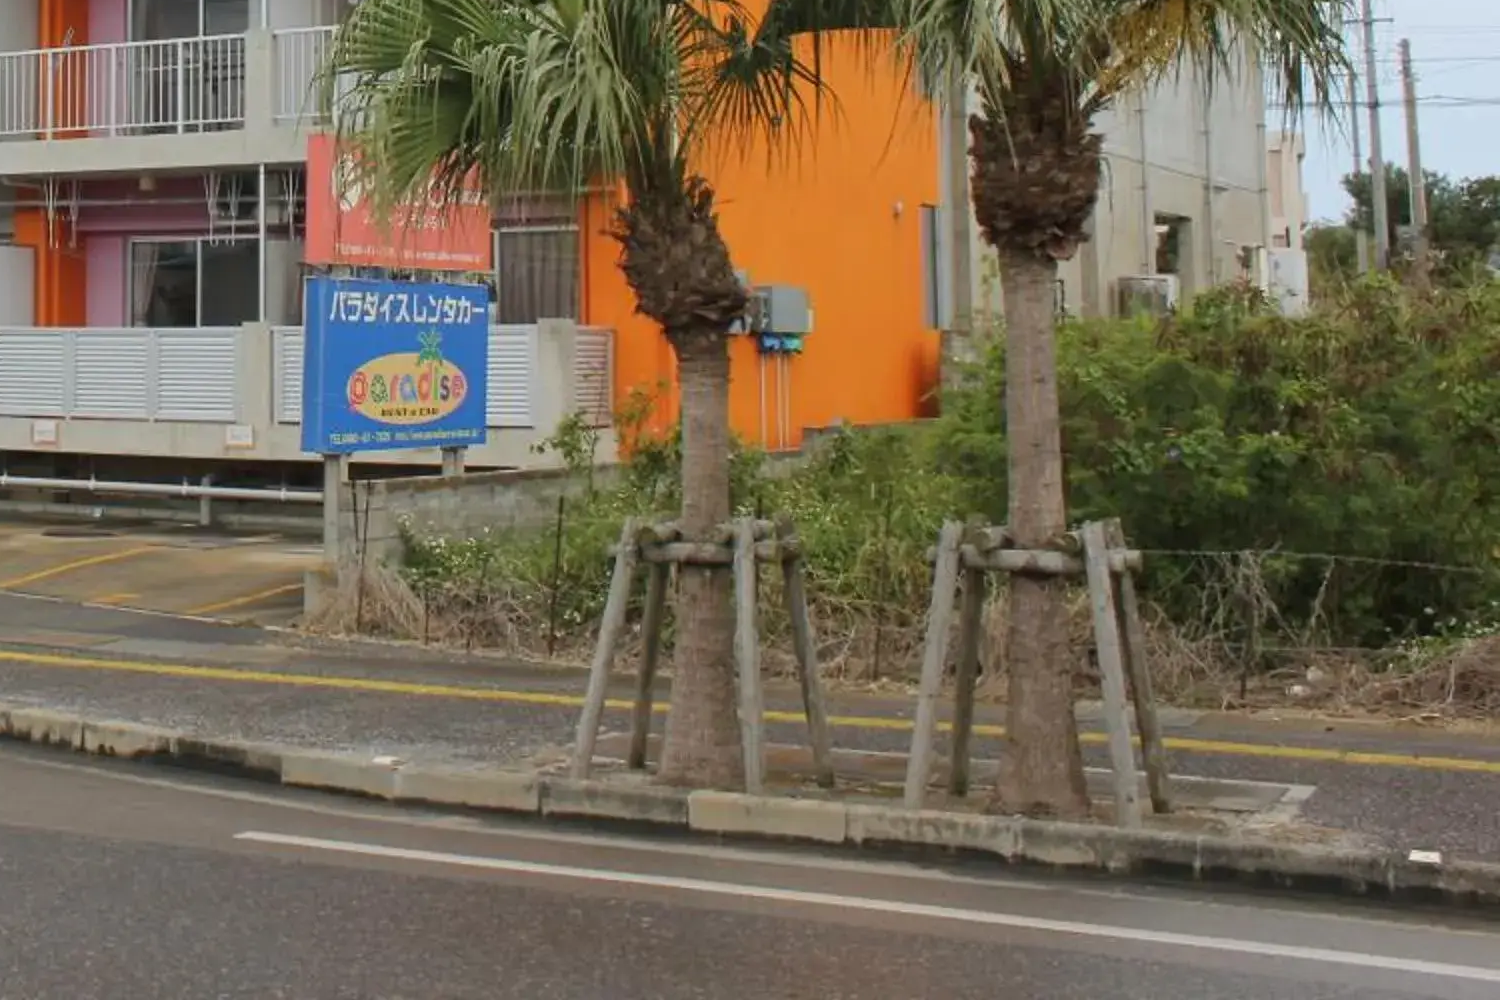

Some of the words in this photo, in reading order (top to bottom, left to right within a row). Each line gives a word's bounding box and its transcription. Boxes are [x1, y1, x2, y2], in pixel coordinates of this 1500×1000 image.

[329, 291, 485, 324] パラダイスレンタカー
[349, 364, 465, 412] paradise
